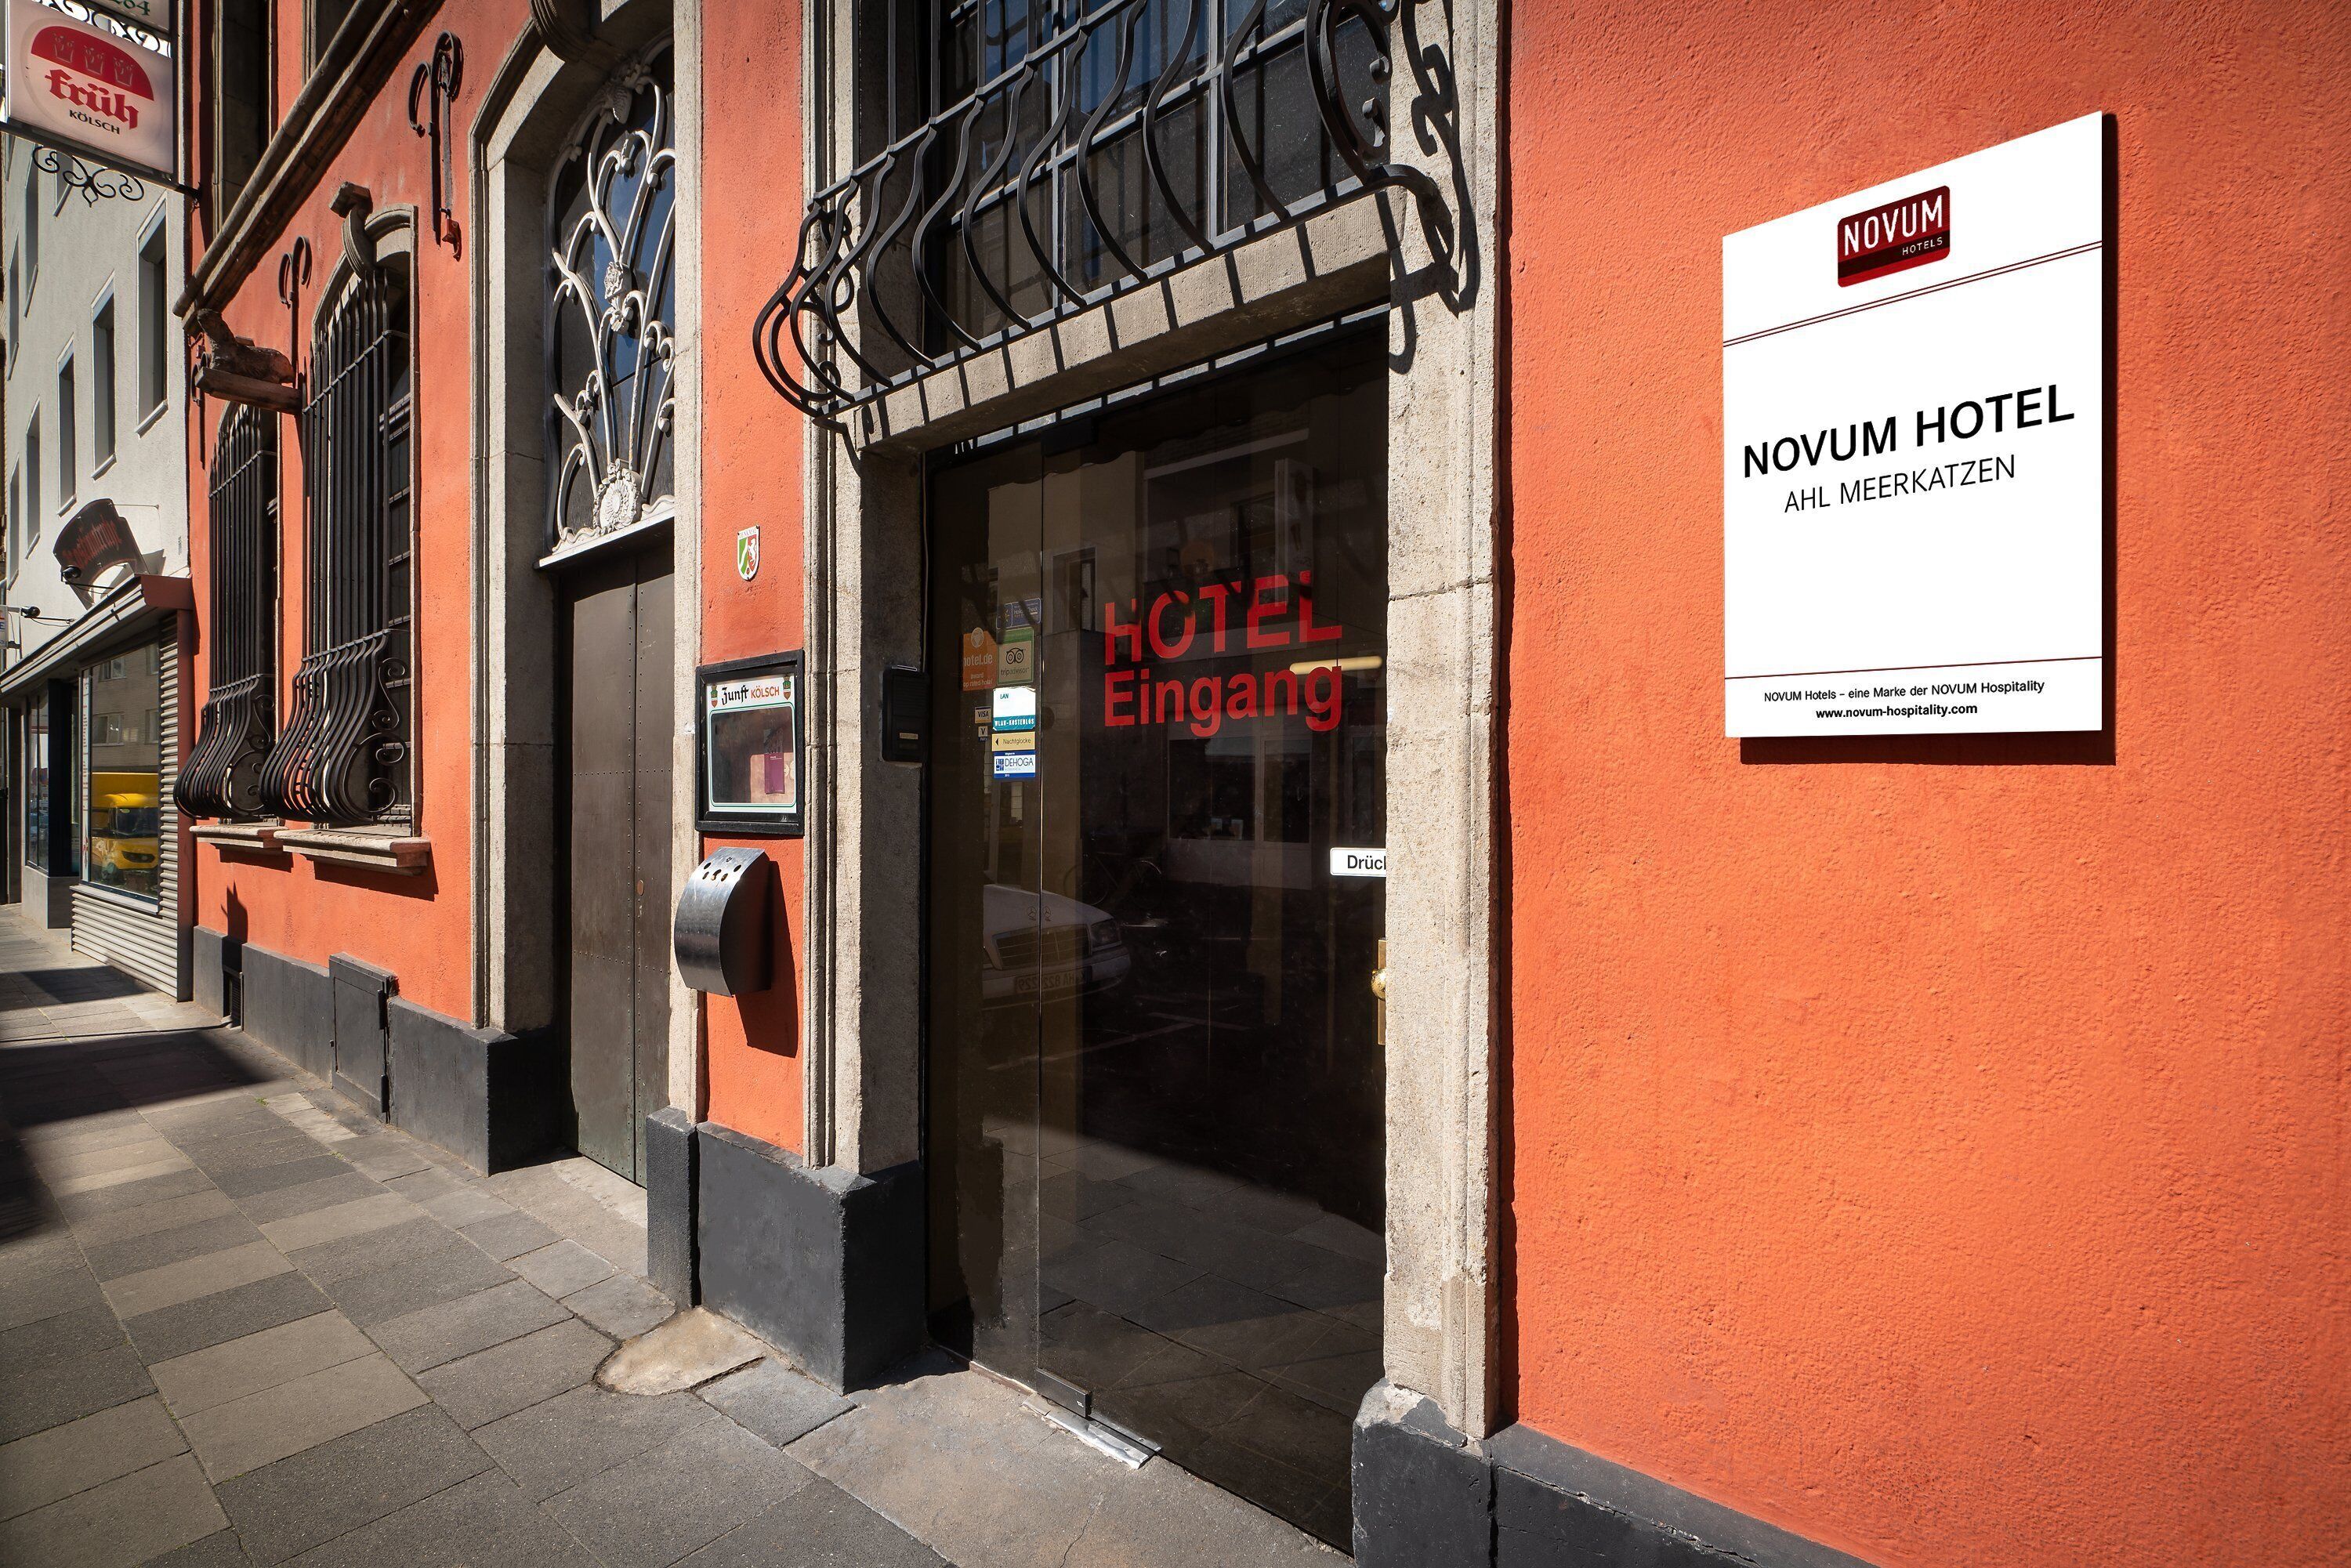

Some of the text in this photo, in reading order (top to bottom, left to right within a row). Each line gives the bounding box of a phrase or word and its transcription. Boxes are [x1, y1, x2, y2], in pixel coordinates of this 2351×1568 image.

[45, 69, 139, 129] früh
[69, 110, 120, 135] KÖLSCH
[1845, 195, 1943, 256] NOVUM
[1902, 237, 1943, 255] HOTELS
[1744, 384, 2075, 478] NOVUM HOTEL
[1784, 454, 2016, 512] AHL MEERKATZEN
[1105, 570, 1342, 665] HOTEL
[1001, 667, 1028, 676] tripadvisor
[751, 685, 780, 699] KÖLSCH
[1104, 665, 1342, 737] Eingang
[1764, 691, 1802, 702] NOVUM
[1806, 690, 1837, 701] Hotels
[1849, 688, 1870, 699] eine
[1874, 686, 1907, 697] Marke
[1910, 686, 1929, 696] der
[1932, 683, 1977, 695] NOVUM
[1981, 679, 2045, 694] Hospitality
[1816, 704, 1978, 719] www.novum-hospitality.com
[1005, 757, 1034, 767] DEHOGA
[1347, 854, 1386, 870] Drüc
